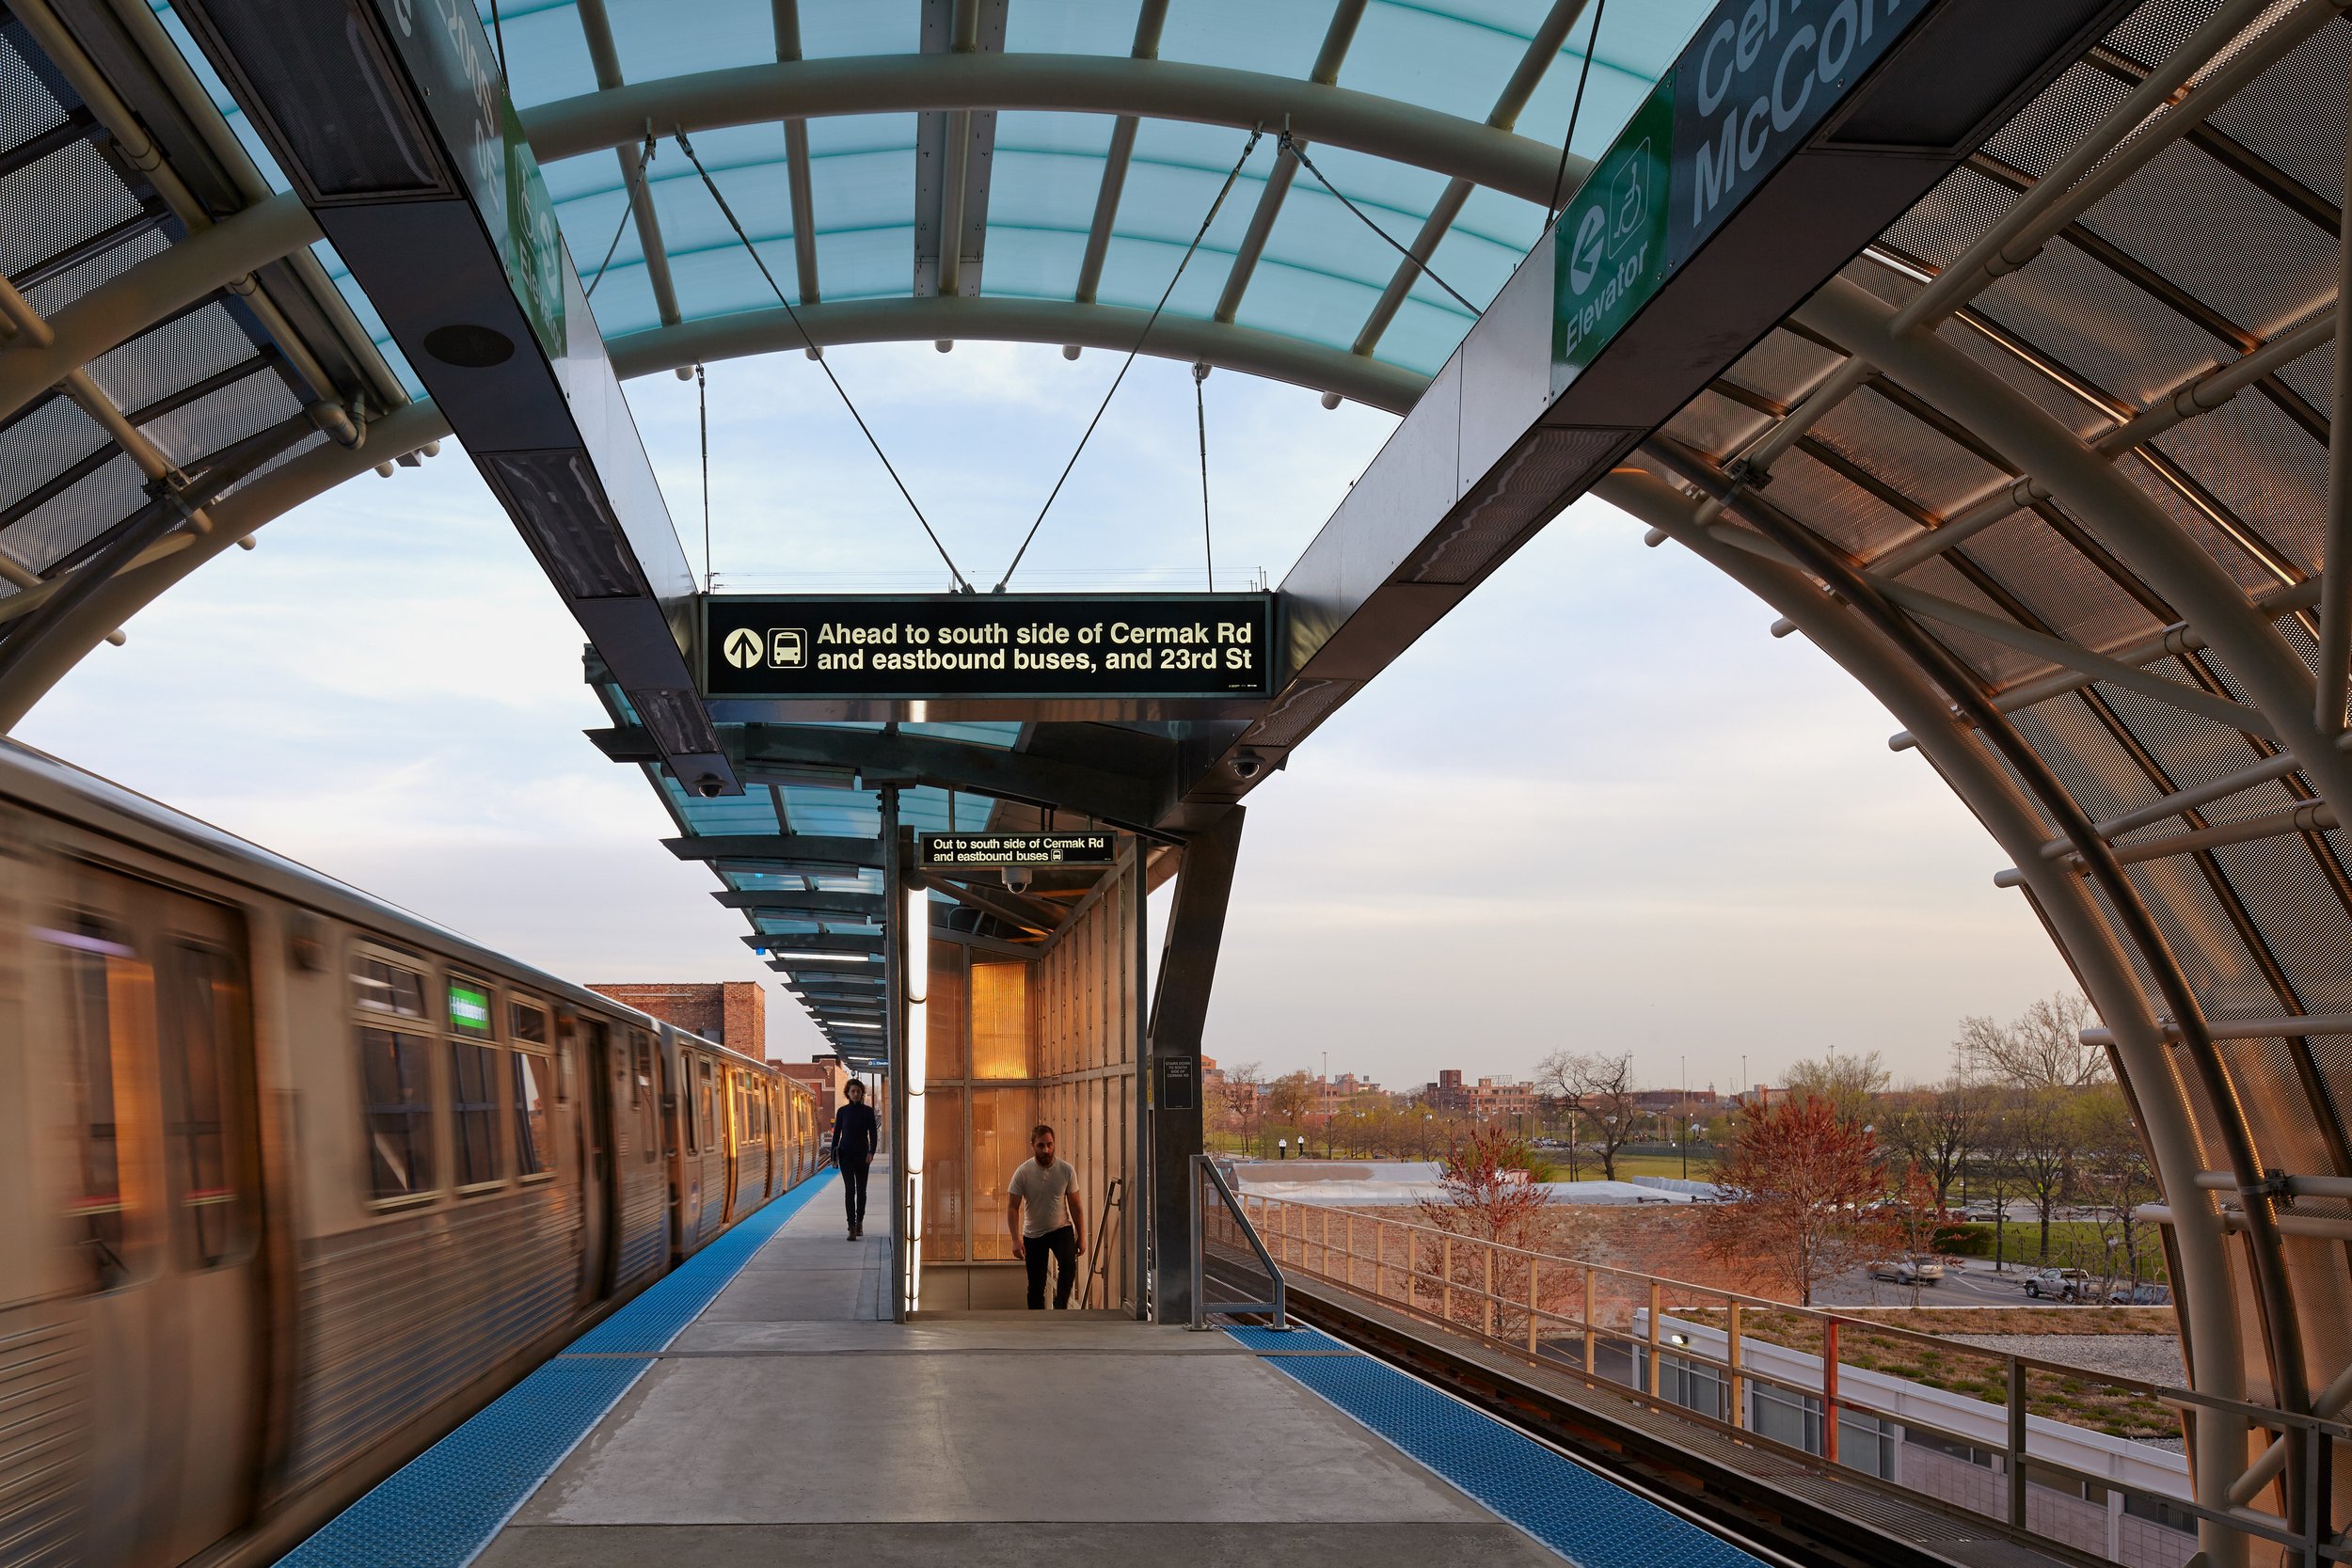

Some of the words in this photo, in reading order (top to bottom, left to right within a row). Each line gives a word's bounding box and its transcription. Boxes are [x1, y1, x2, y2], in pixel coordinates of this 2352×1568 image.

[519, 237, 562, 358] Elevator
[1566, 240, 1648, 358] Elevator
[817, 623, 898, 644] Ahead
[905, 624, 930, 644] to
[938, 623, 1009, 644] south
[1016, 623, 1070, 644] side
[1077, 623, 1104, 644] of
[1110, 622, 1210, 644] Cermak
[1217, 623, 1251, 643] Rd
[817, 648, 864, 670] and
[872, 648, 1006, 670] eastbound
[1014, 648, 1097, 673] buses,
[1105, 648, 1152, 670] and
[1160, 647, 1217, 670] 23rd
[1225, 647, 1252, 670] St
[933, 838, 954, 850] Out
[956, 839, 967, 849] to
[970, 838, 1000, 849] south
[1003, 838, 1026, 849] side
[1029, 837, 1041, 849] of
[1042, 837, 1086, 848] Cermak
[1088, 837, 1104, 848] Rd
[933, 850, 954, 863] and
[957, 850, 1014, 863] eastbound
[1016, 850, 1049, 862] buses
